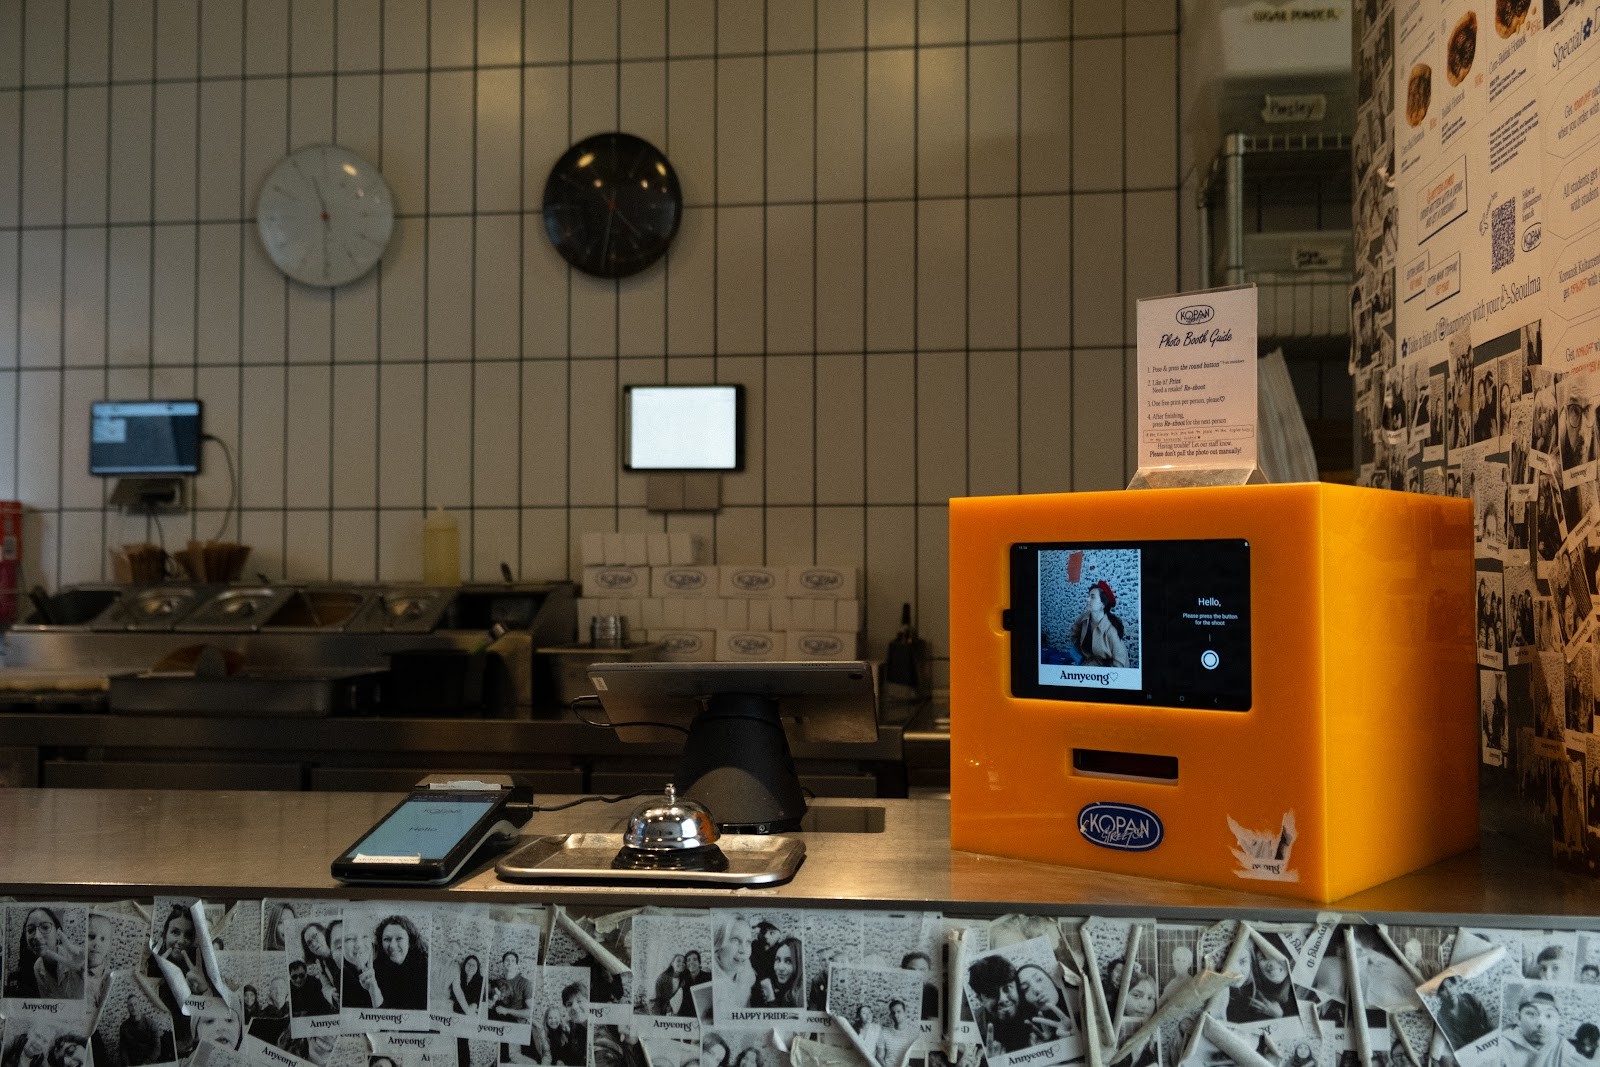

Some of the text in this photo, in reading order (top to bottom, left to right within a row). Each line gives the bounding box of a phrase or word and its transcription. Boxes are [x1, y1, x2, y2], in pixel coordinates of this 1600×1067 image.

[1553, 21, 1583, 70] Special
[1473, 299, 1486, 322] with
[1486, 298, 1500, 321] your
[1511, 275, 1541, 304] Seoulma
[1180, 309, 1210, 321] KOPAN
[1159, 328, 1232, 349] Photo Booth Guide
[1176, 450, 1186, 458] pull
[1198, 597, 1222, 607] Hello,
[1060, 670, 1110, 685] Annyeong
[1090, 812, 1149, 839] KOPAN
[358, 1012, 402, 1024] Annyeong
[732, 1012, 788, 1020] HAPPY PRIDE
[388, 1036, 426, 1048] Anyeong
[1008, 1047, 1054, 1066] Annyeong
